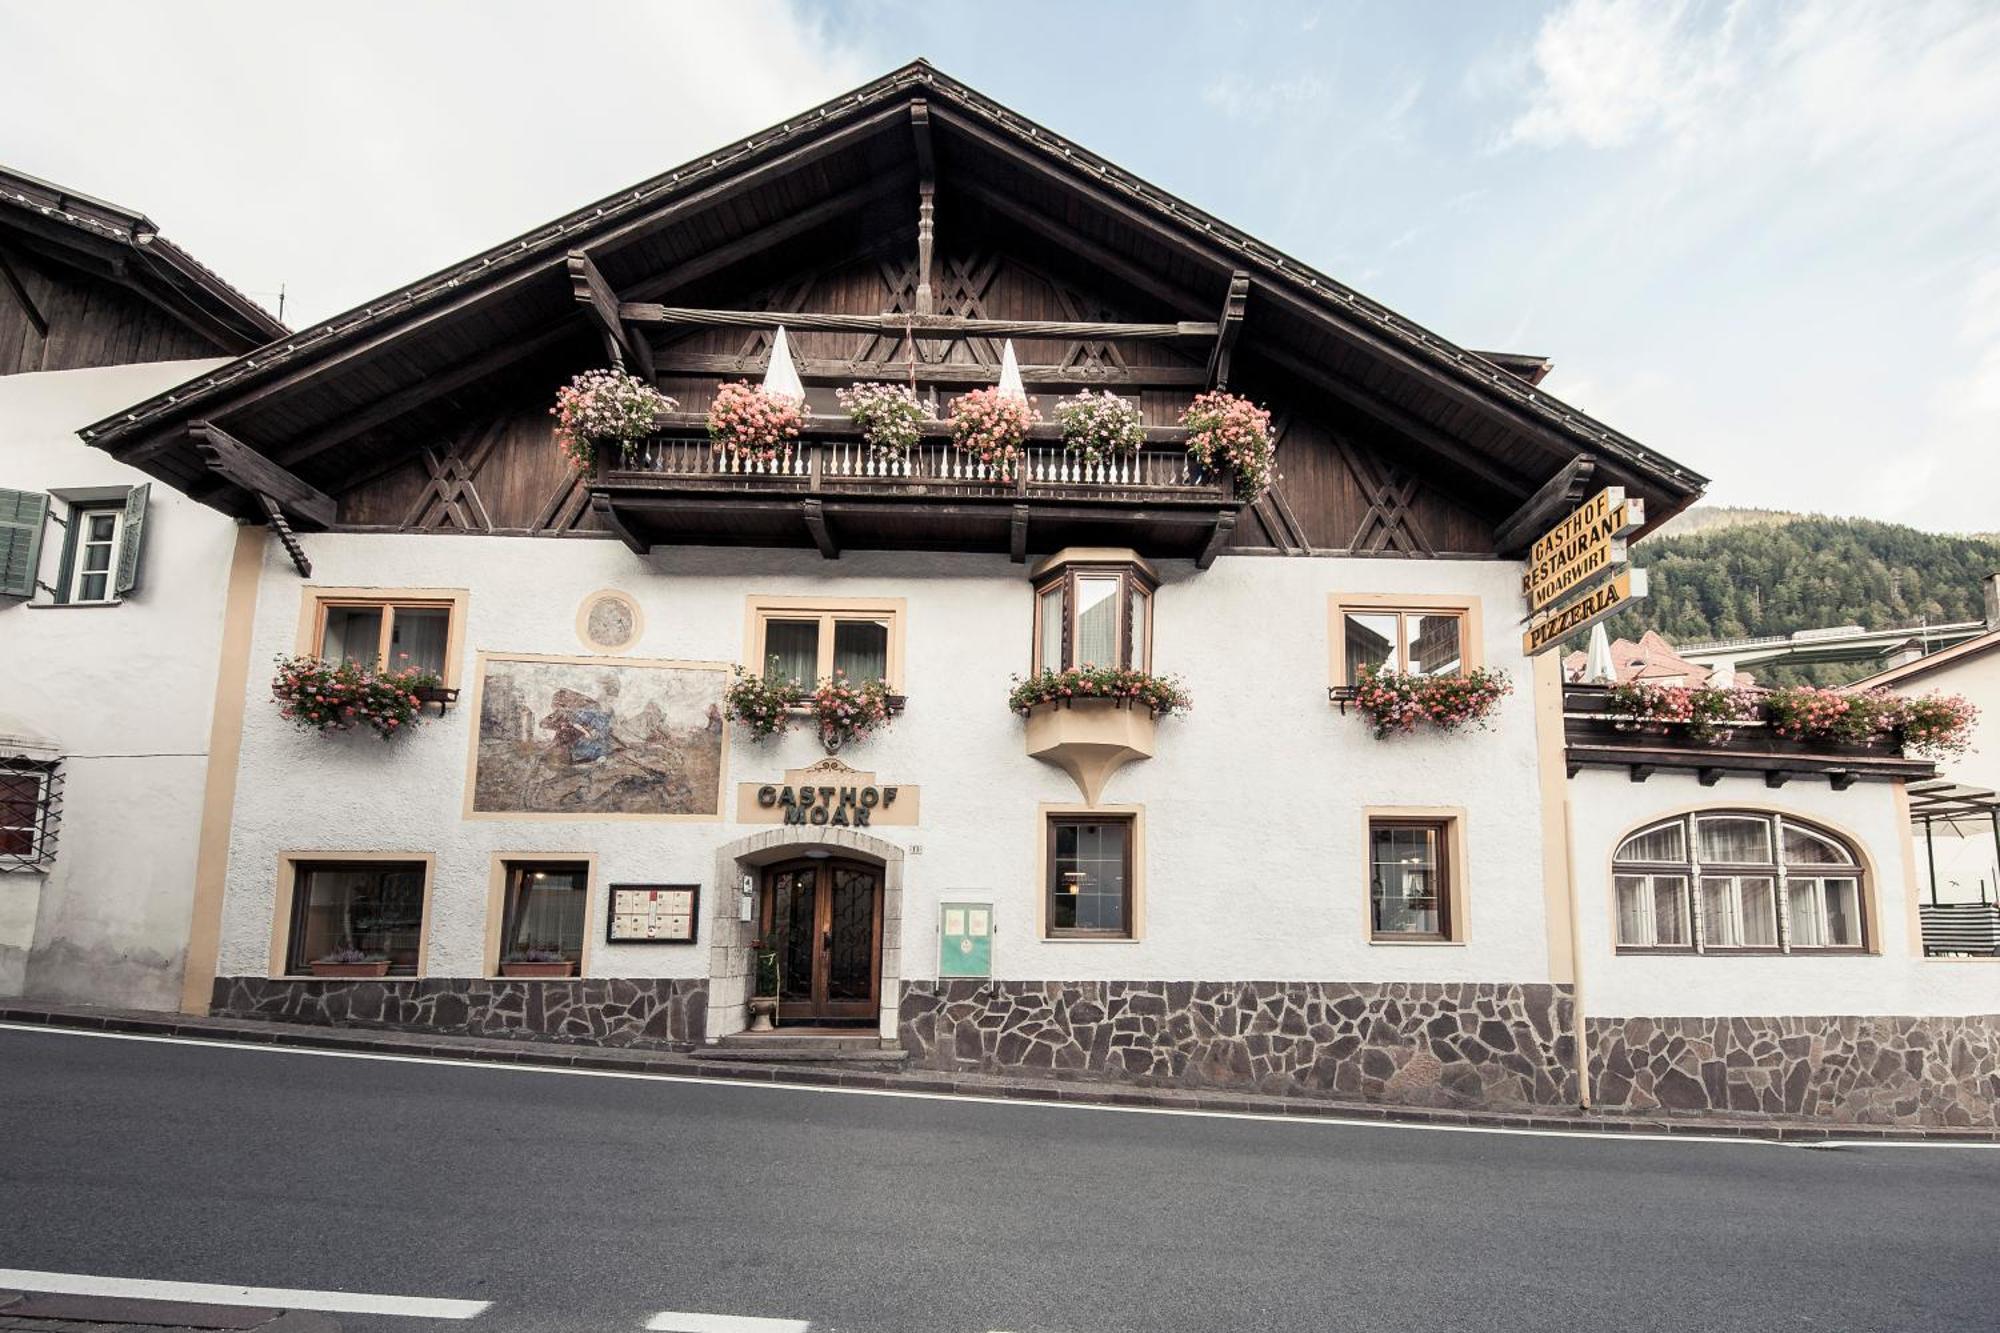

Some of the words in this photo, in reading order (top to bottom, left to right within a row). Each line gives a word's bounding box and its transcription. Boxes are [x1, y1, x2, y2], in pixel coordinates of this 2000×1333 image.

[1522, 505, 1626, 594] RESTAURANT
[1535, 494, 1606, 562] GASTHOF
[1536, 544, 1608, 605] MOARWIRT
[1530, 584, 1620, 649] PIZZERIA
[757, 785, 898, 809] GASTHOF
[783, 805, 871, 826] MOAR
